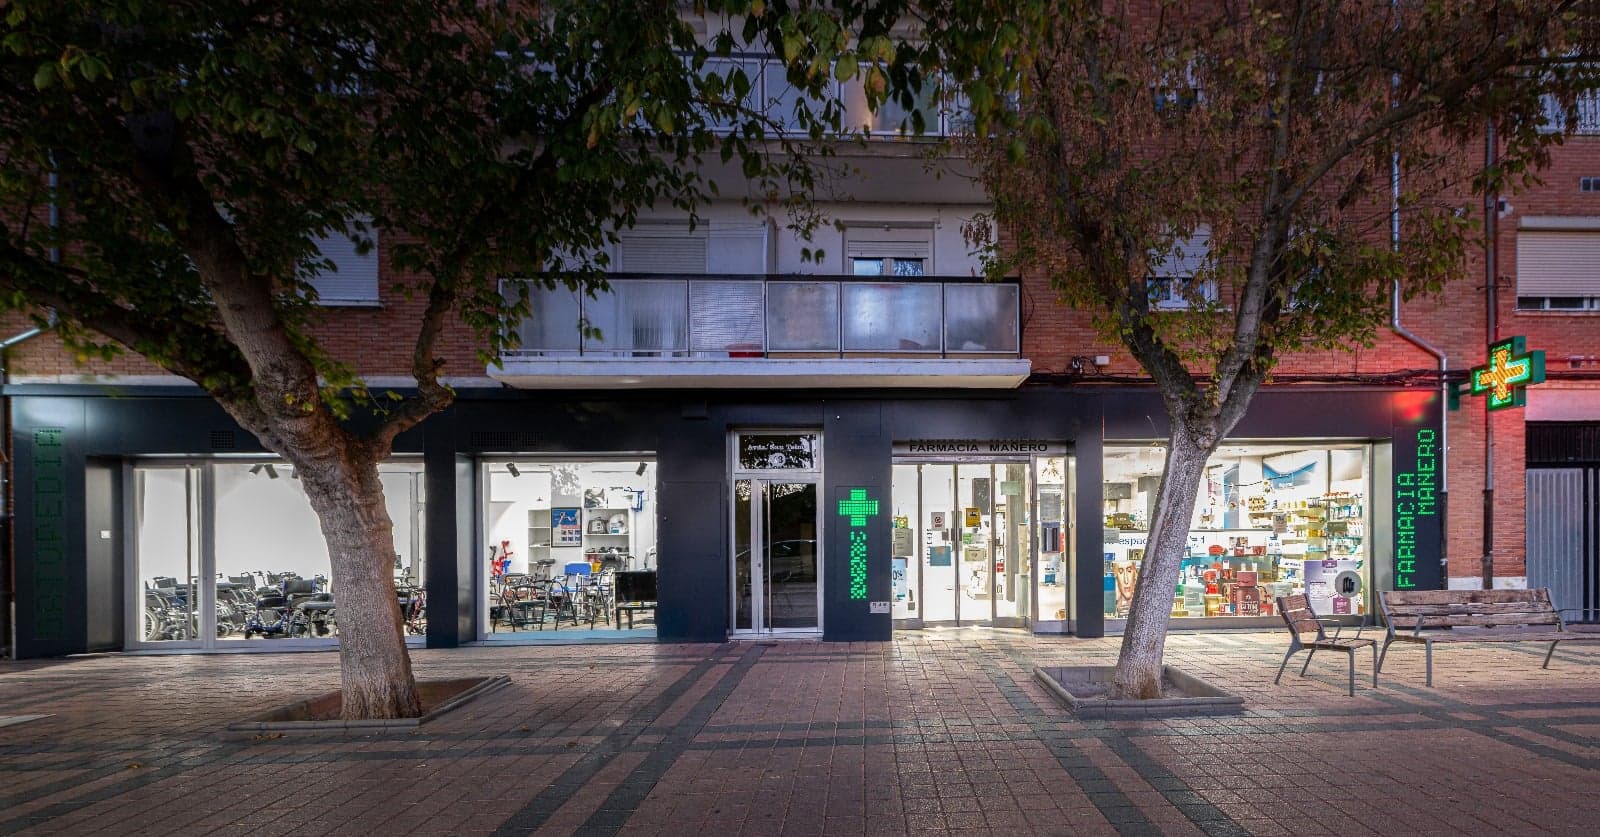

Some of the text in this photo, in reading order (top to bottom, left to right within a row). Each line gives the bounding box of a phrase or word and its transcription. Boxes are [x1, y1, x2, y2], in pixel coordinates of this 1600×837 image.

[910, 443, 1048, 452] FARMACIA MANERO
[1417, 429, 1435, 515] MANERO
[1397, 473, 1416, 588] FARMACIA
